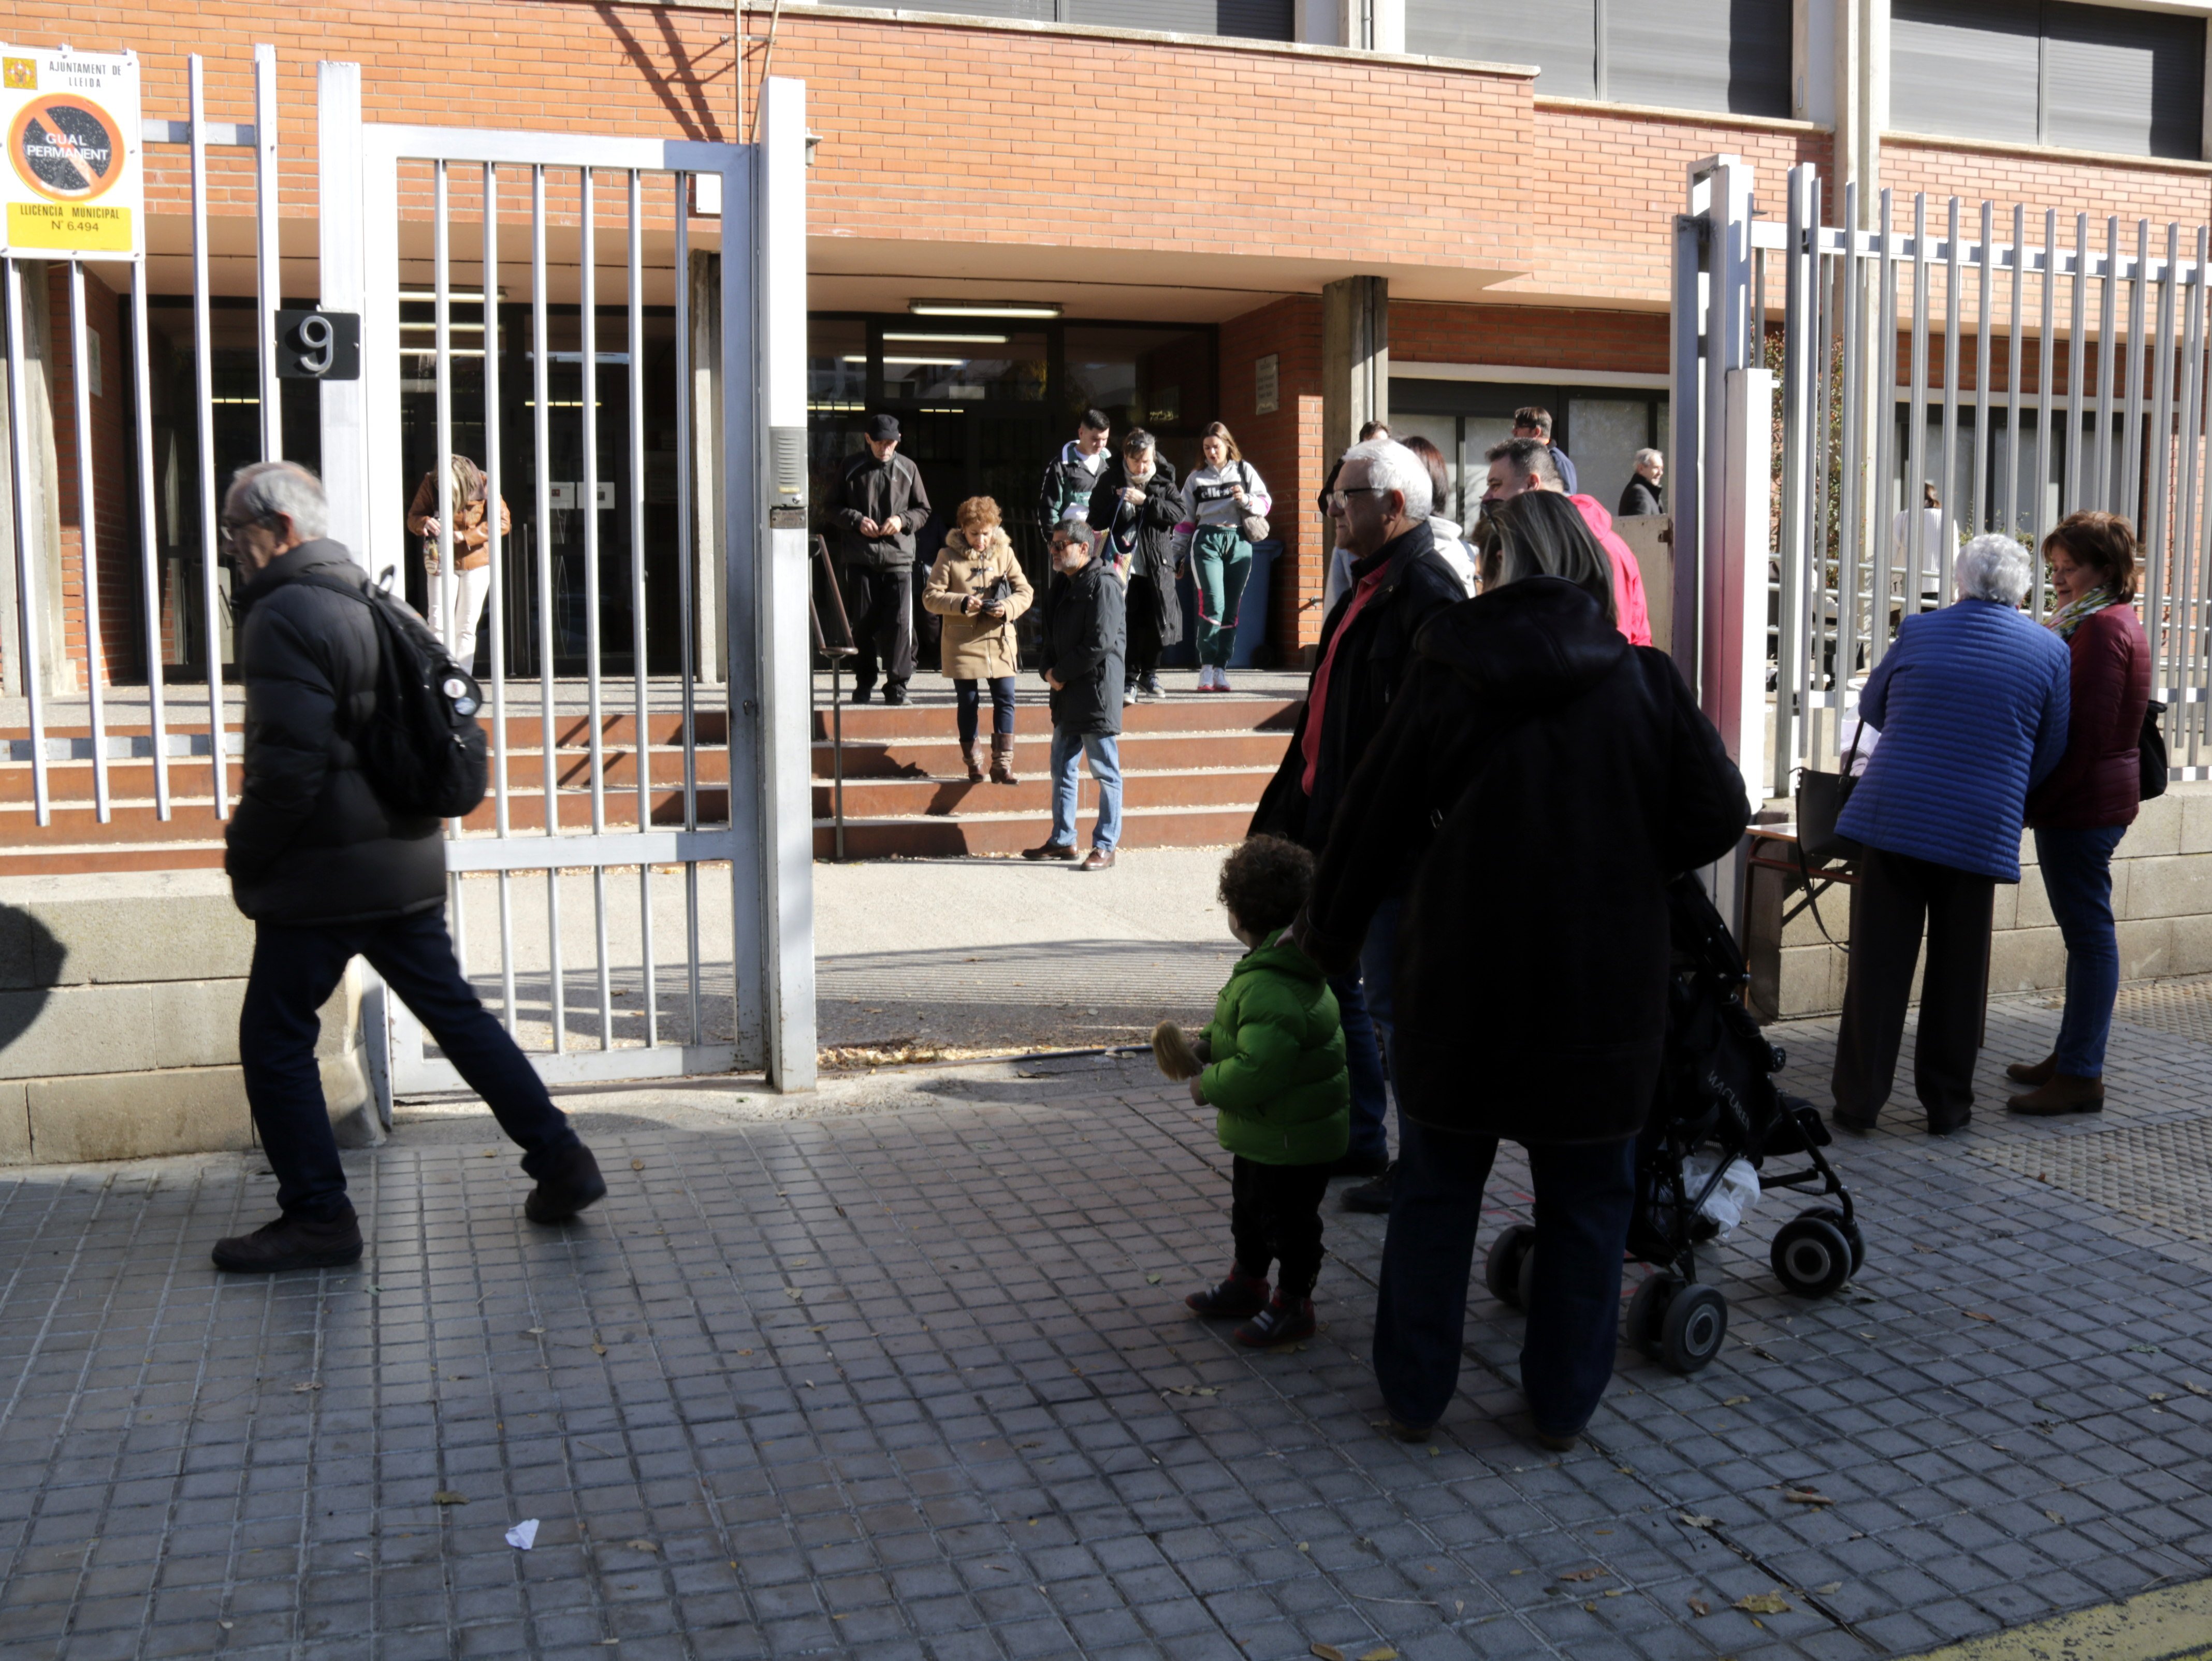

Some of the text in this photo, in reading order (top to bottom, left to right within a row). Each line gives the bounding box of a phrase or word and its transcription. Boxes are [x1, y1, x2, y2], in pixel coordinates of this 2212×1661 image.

[49, 61, 122, 76] AJUNTAMENT DE
[69, 77, 101, 88] LLEIDA
[46, 133, 87, 147] GUAL
[26, 145, 108, 161] PERMANENT
[20, 204, 120, 219] LLICÈNCIA MUNICIPAL
[67, 221, 99, 232] 6.494
[299, 315, 333, 372] 9
